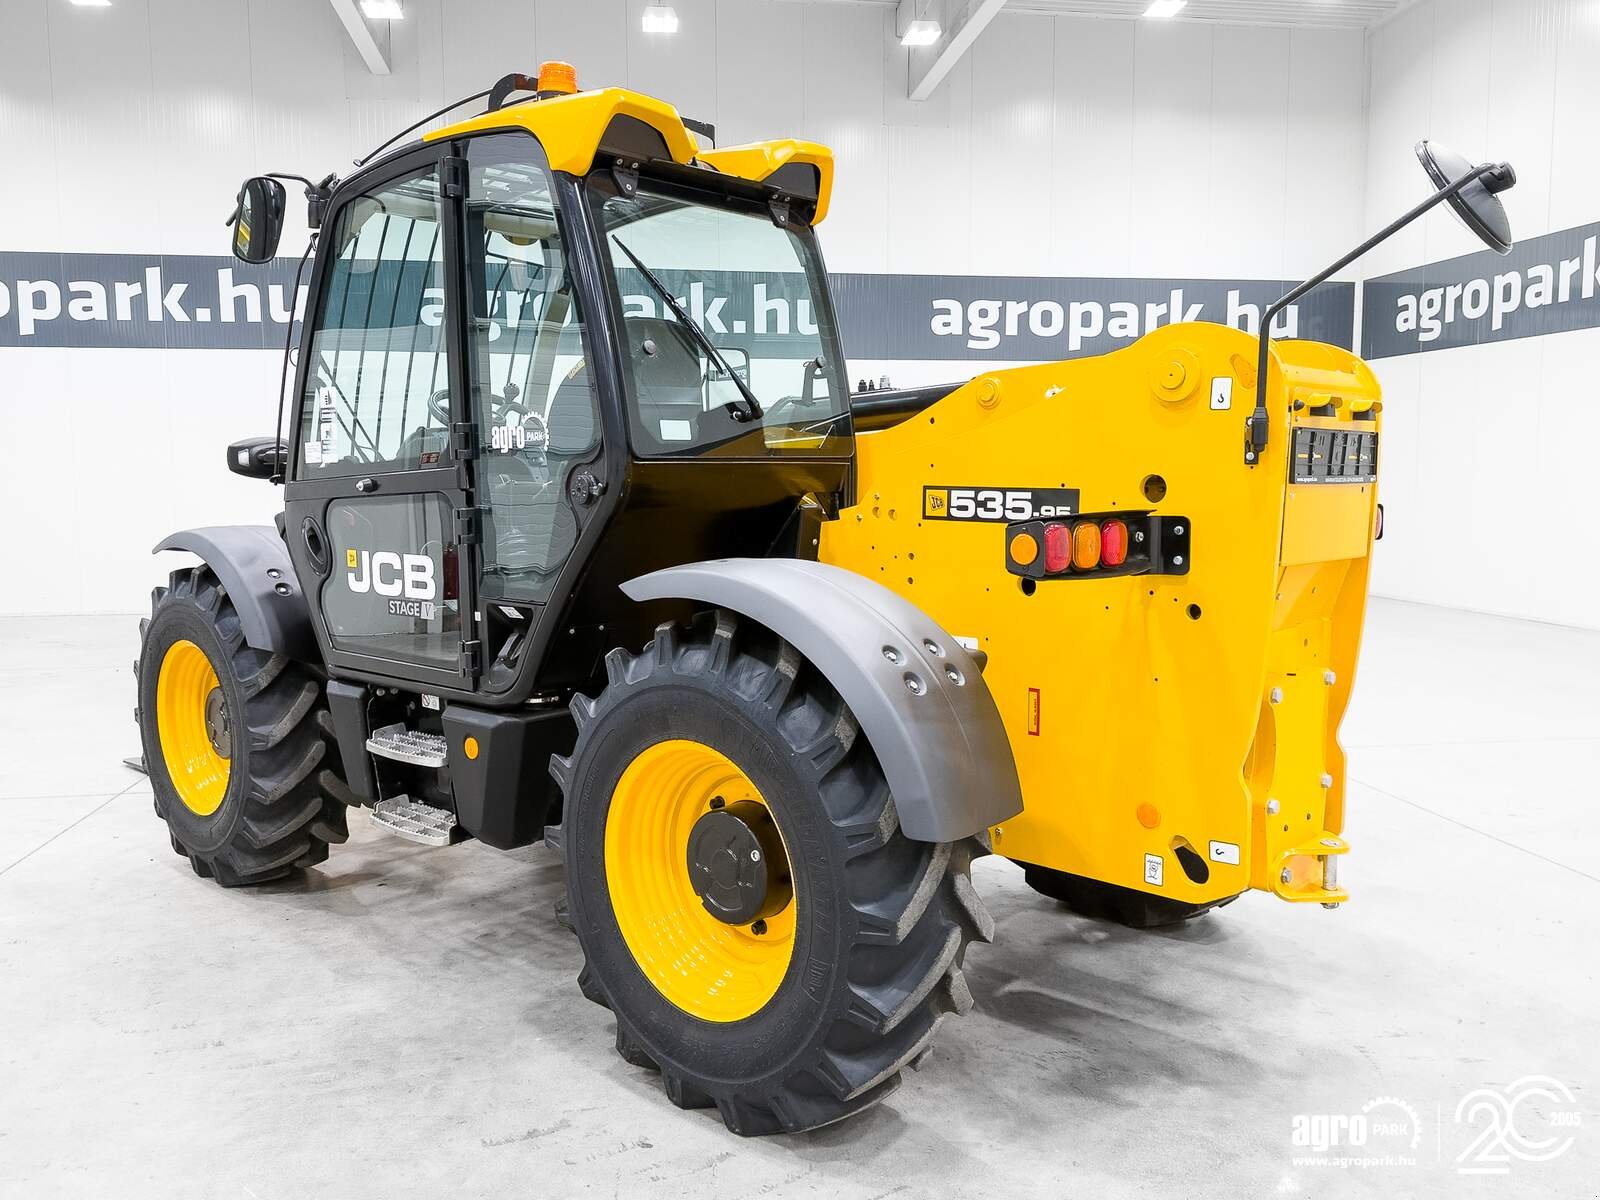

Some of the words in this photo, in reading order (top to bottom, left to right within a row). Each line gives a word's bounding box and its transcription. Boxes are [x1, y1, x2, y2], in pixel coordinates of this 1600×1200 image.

[0, 266, 309, 336] park.hu
[491, 425, 525, 454] agro
[526, 431, 545, 441] PARK
[347, 550, 436, 601] JCB
[389, 600, 420, 616] STAGE
[422, 602, 433, 618] V
